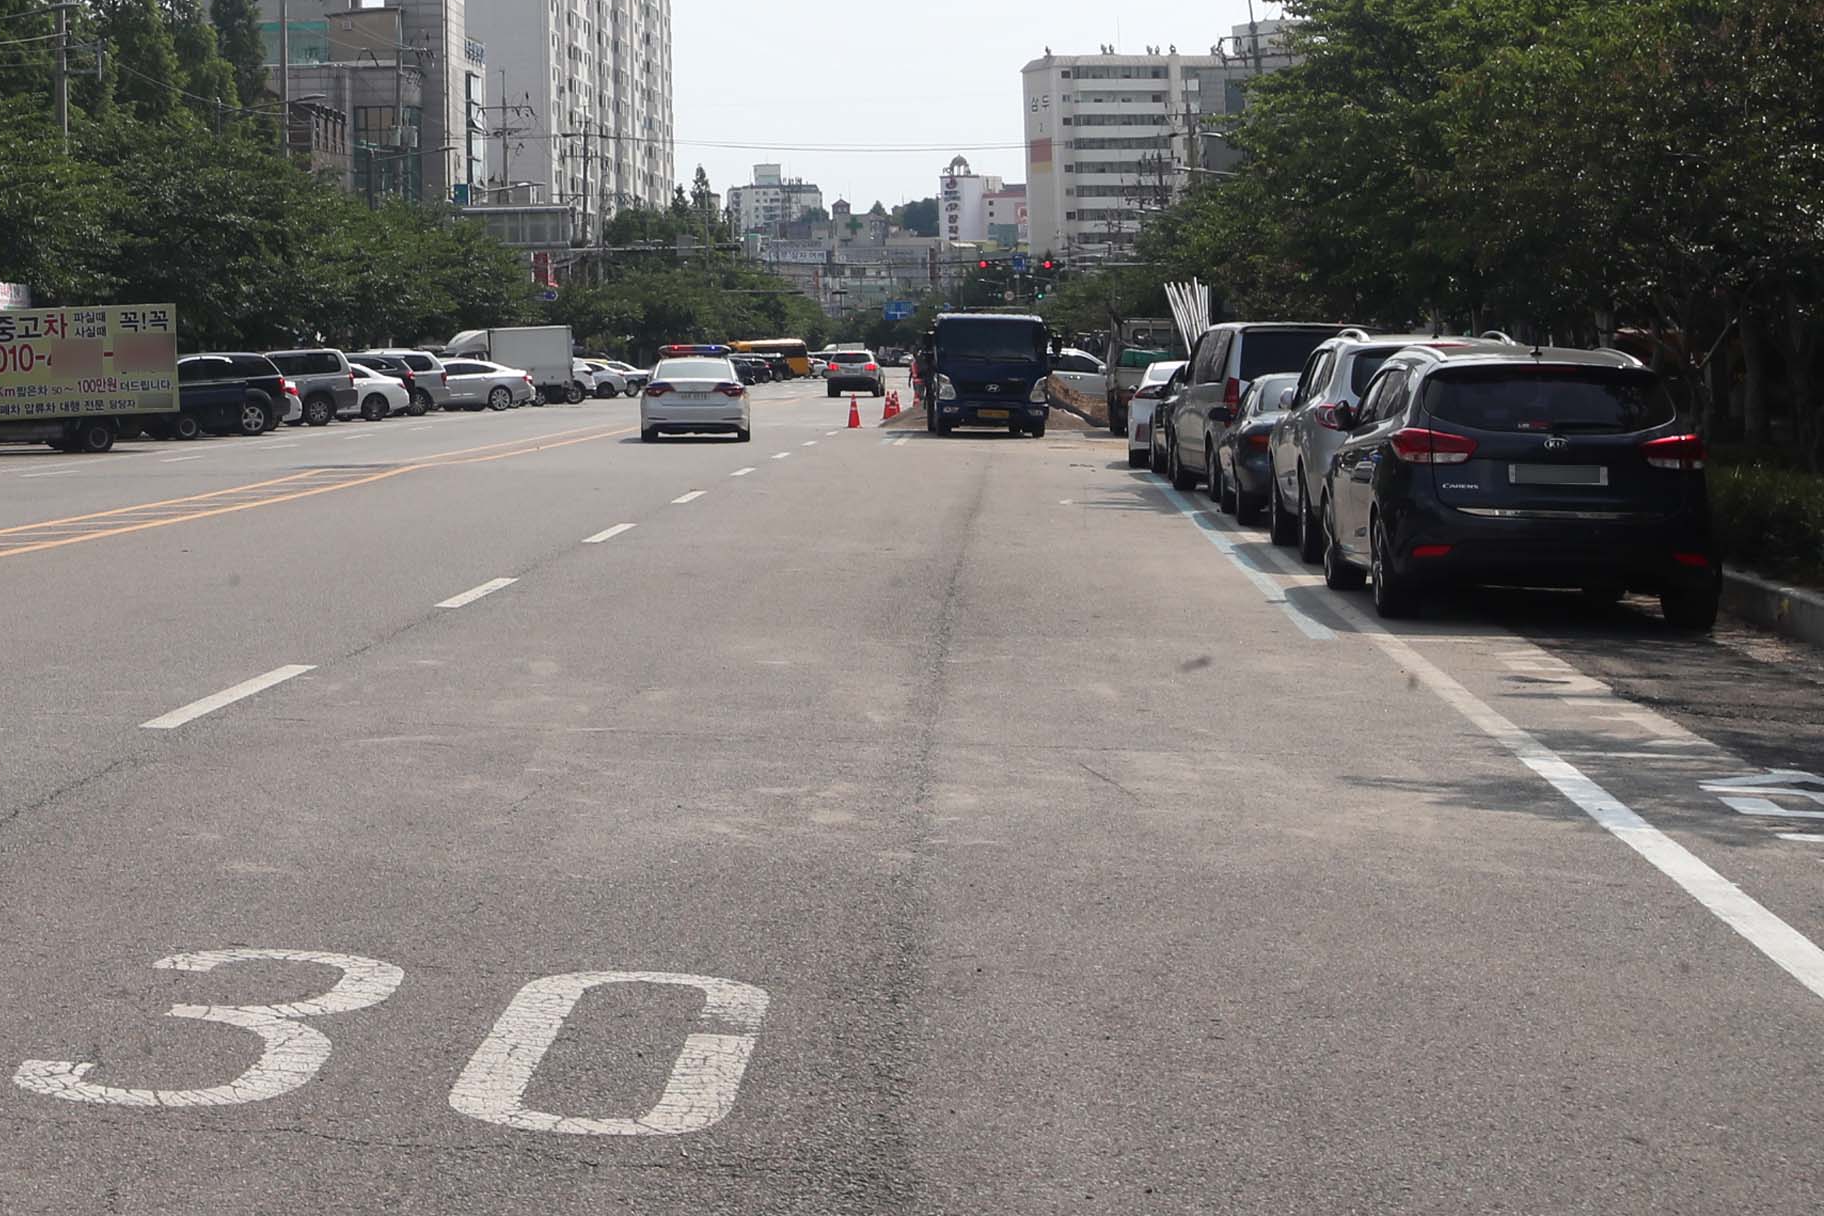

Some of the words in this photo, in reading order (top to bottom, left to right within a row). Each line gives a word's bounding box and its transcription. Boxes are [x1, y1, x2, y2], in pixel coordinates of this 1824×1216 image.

[73, 311, 107, 325] 파실때
[119, 310, 169, 333] 꼭!꼭
[74, 325, 107, 338] 사실때
[77, 377, 118, 394] 100만원
[12, 948, 772, 1137] 30
